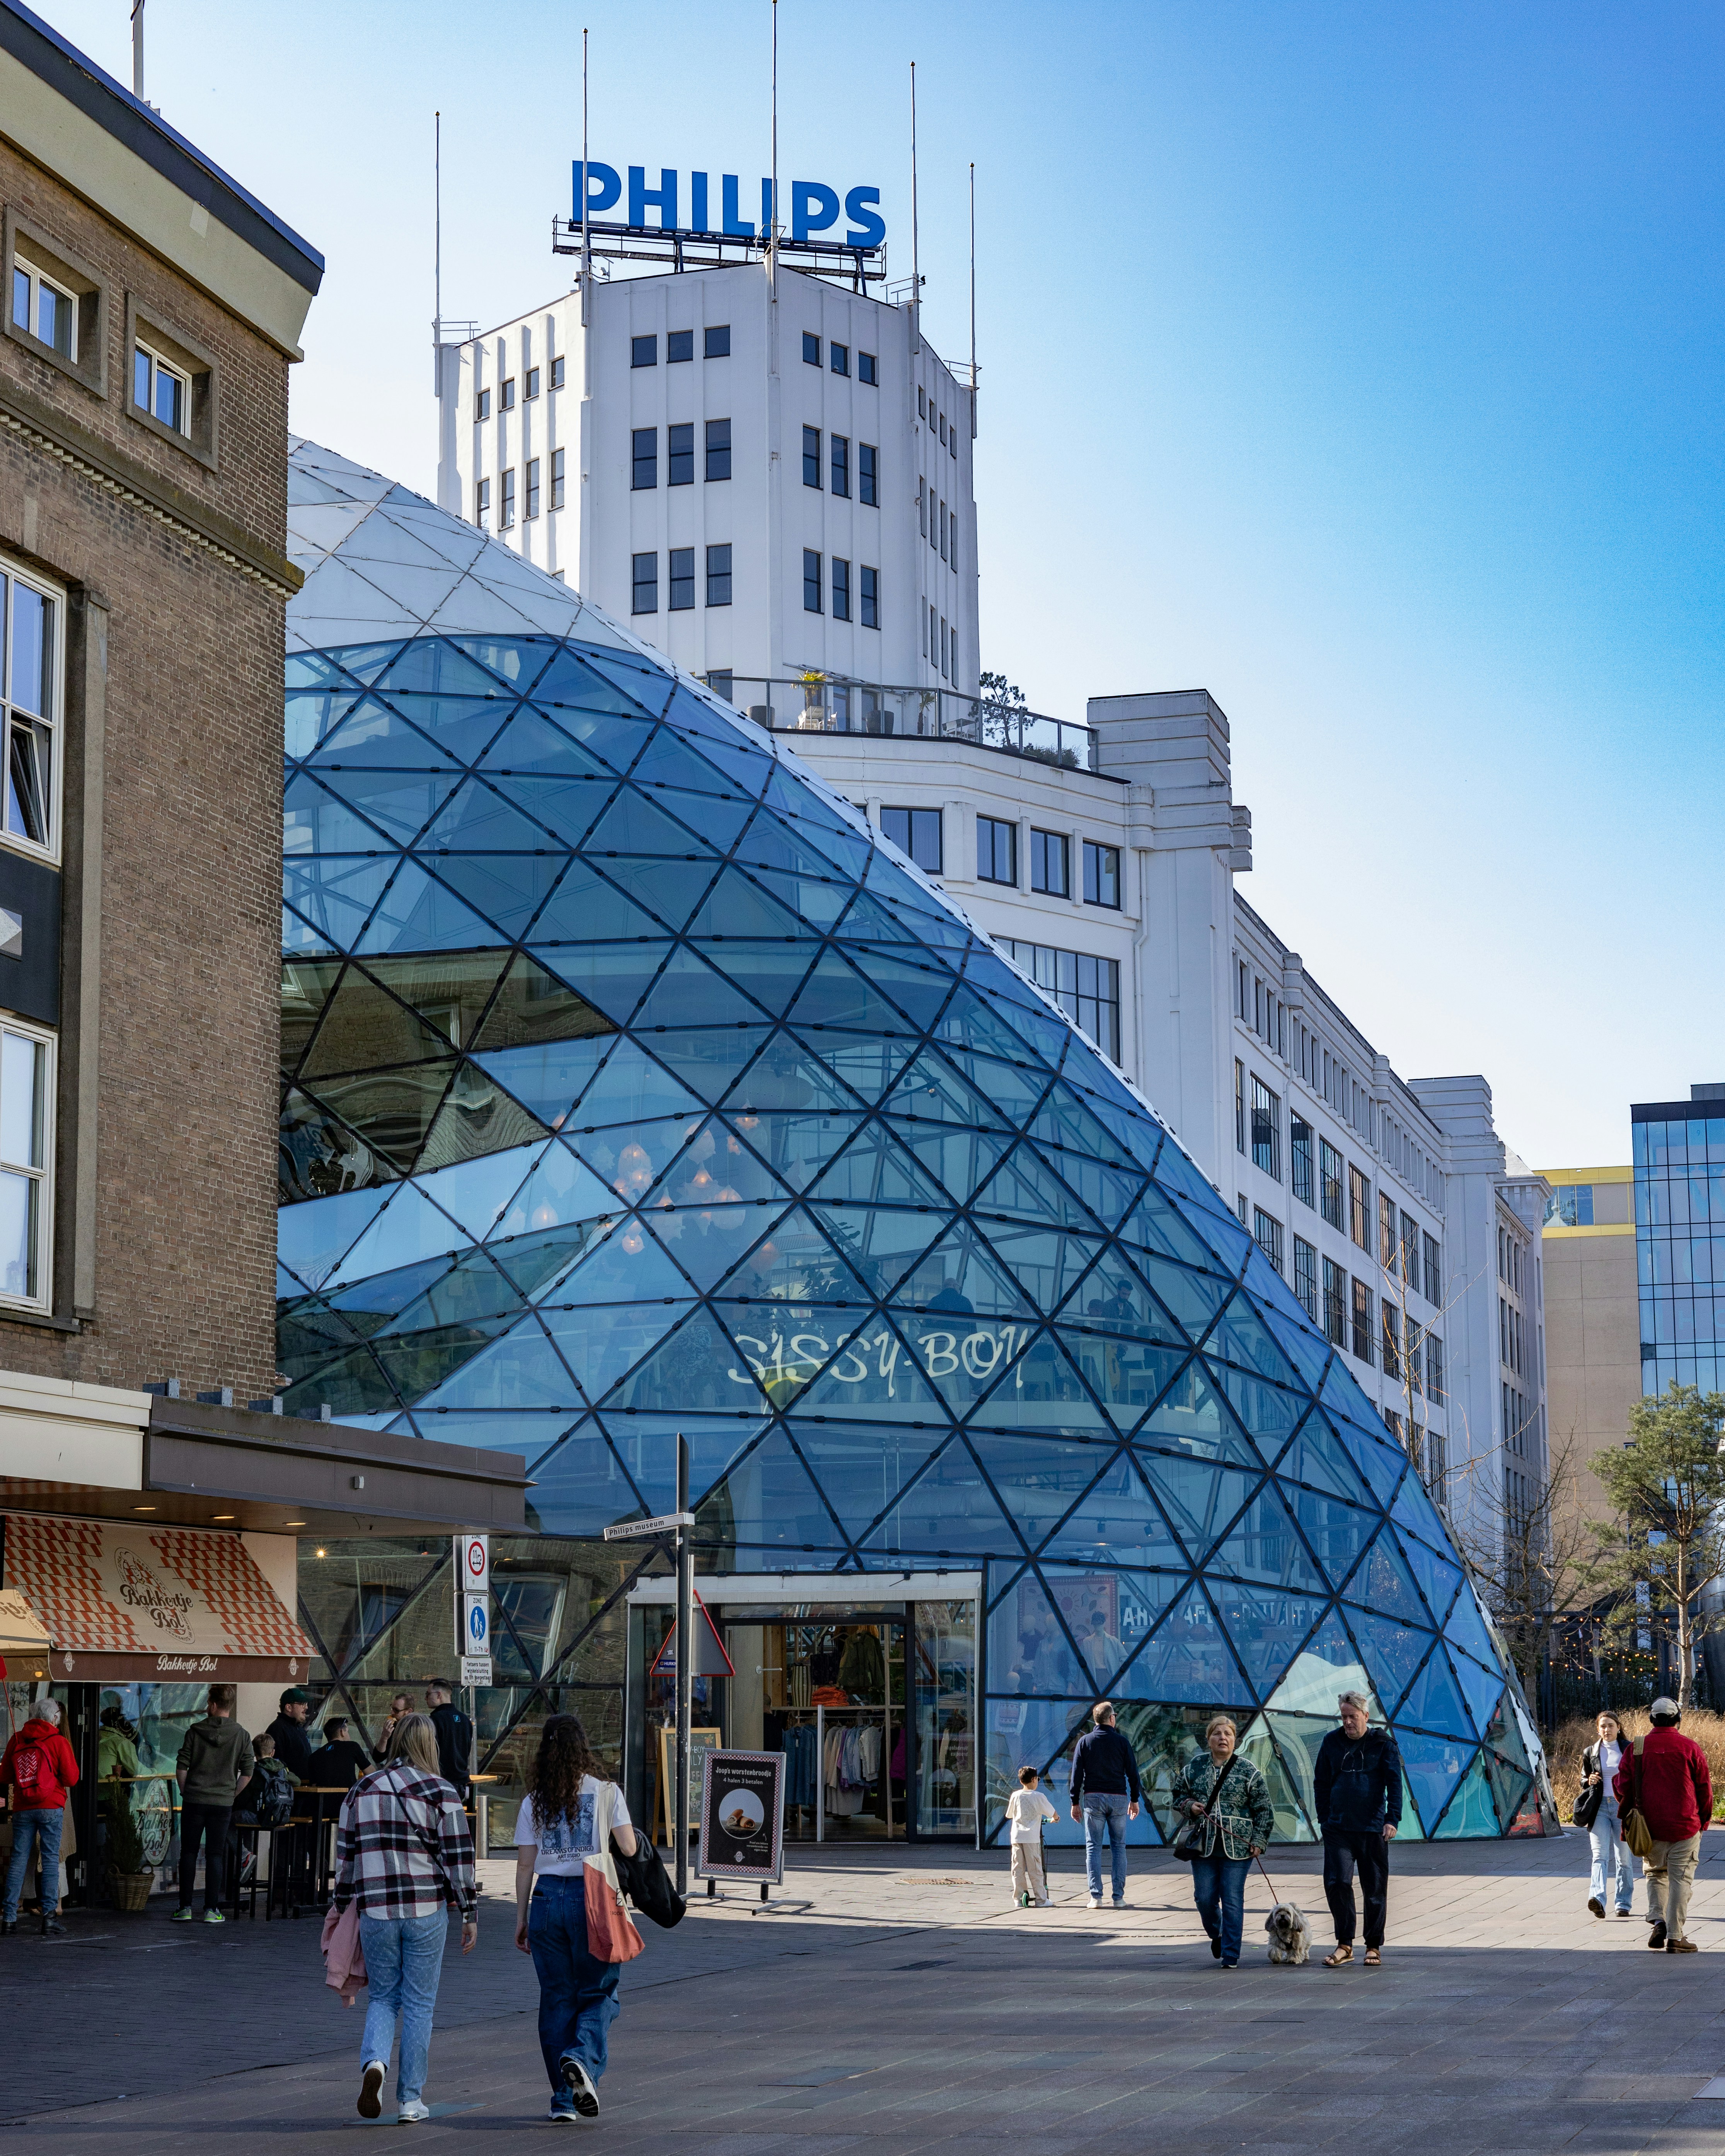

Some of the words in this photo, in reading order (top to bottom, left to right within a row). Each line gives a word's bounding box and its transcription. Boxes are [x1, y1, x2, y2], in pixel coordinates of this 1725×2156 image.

[572, 160, 886, 248] PHILIPS
[609, 1527, 633, 1536] Philips
[635, 1520, 664, 1531] museum
[473, 1550, 477, 1559] 11
[119, 1584, 193, 1613] Bakkertje
[150, 1608, 184, 1628] Bol
[157, 1654, 198, 1674] Bakkertje
[198, 1655, 218, 1672] Bol
[715, 1767, 731, 1775] Joop's
[731, 1769, 772, 1778] worstenbroodje
[143, 1831, 165, 1852] Bol
